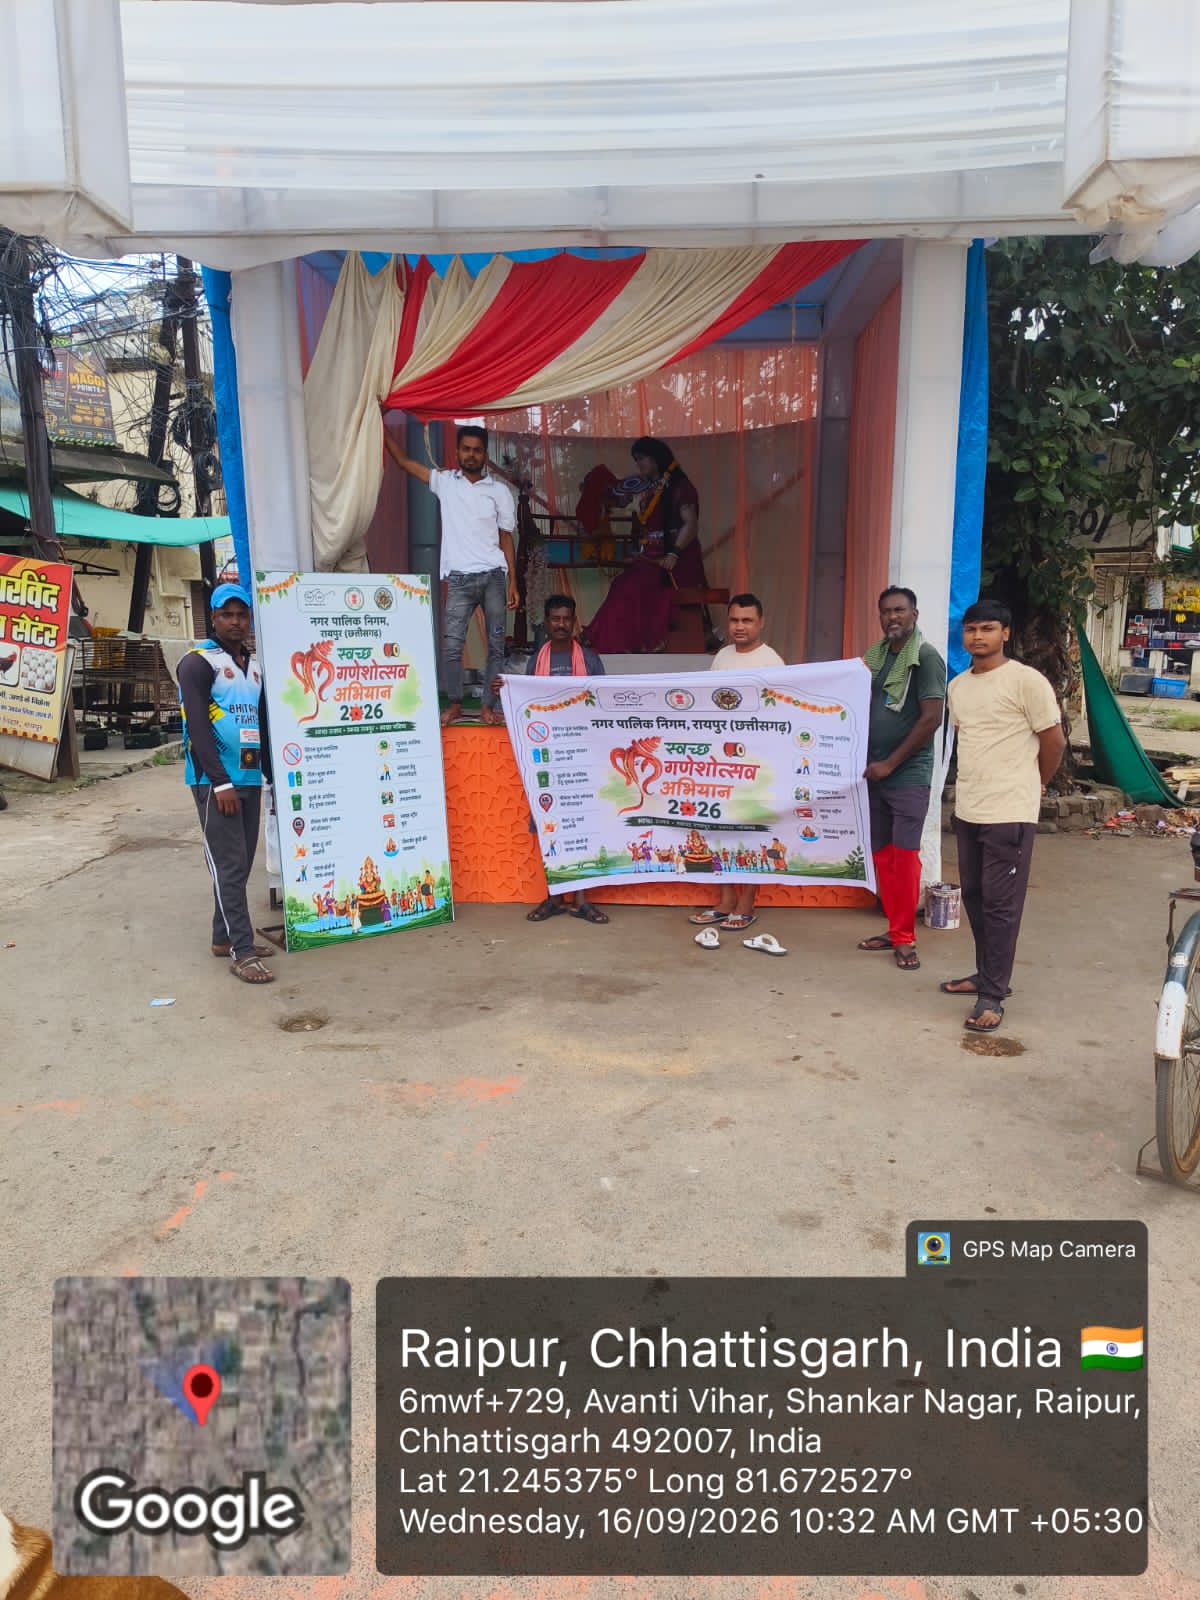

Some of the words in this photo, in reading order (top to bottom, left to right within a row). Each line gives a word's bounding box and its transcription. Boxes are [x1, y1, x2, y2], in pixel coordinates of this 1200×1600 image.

[11, 611, 60, 647] सेंटर
[310, 617, 329, 627] नगर
[331, 615, 361, 627] पालिक
[320, 629, 342, 641] रायपुर
[337, 647, 373, 660] स्वच्छ
[336, 659, 409, 681] गणेशोत्सव
[333, 681, 393, 702] अभियान
[340, 703, 384, 721] 226
[591, 718, 613, 730] नगर
[616, 716, 654, 730] पालिक
[656, 716, 690, 732] निगम,
[693, 719, 727, 734] रायपुर
[730, 717, 792, 735] (छत्तीसगढ़)
[664, 742, 712, 755] स्वच्छ
[664, 755, 760, 781] गणेशोत्सव
[659, 777, 734, 800] अभियान
[668, 799, 721, 819] 226
